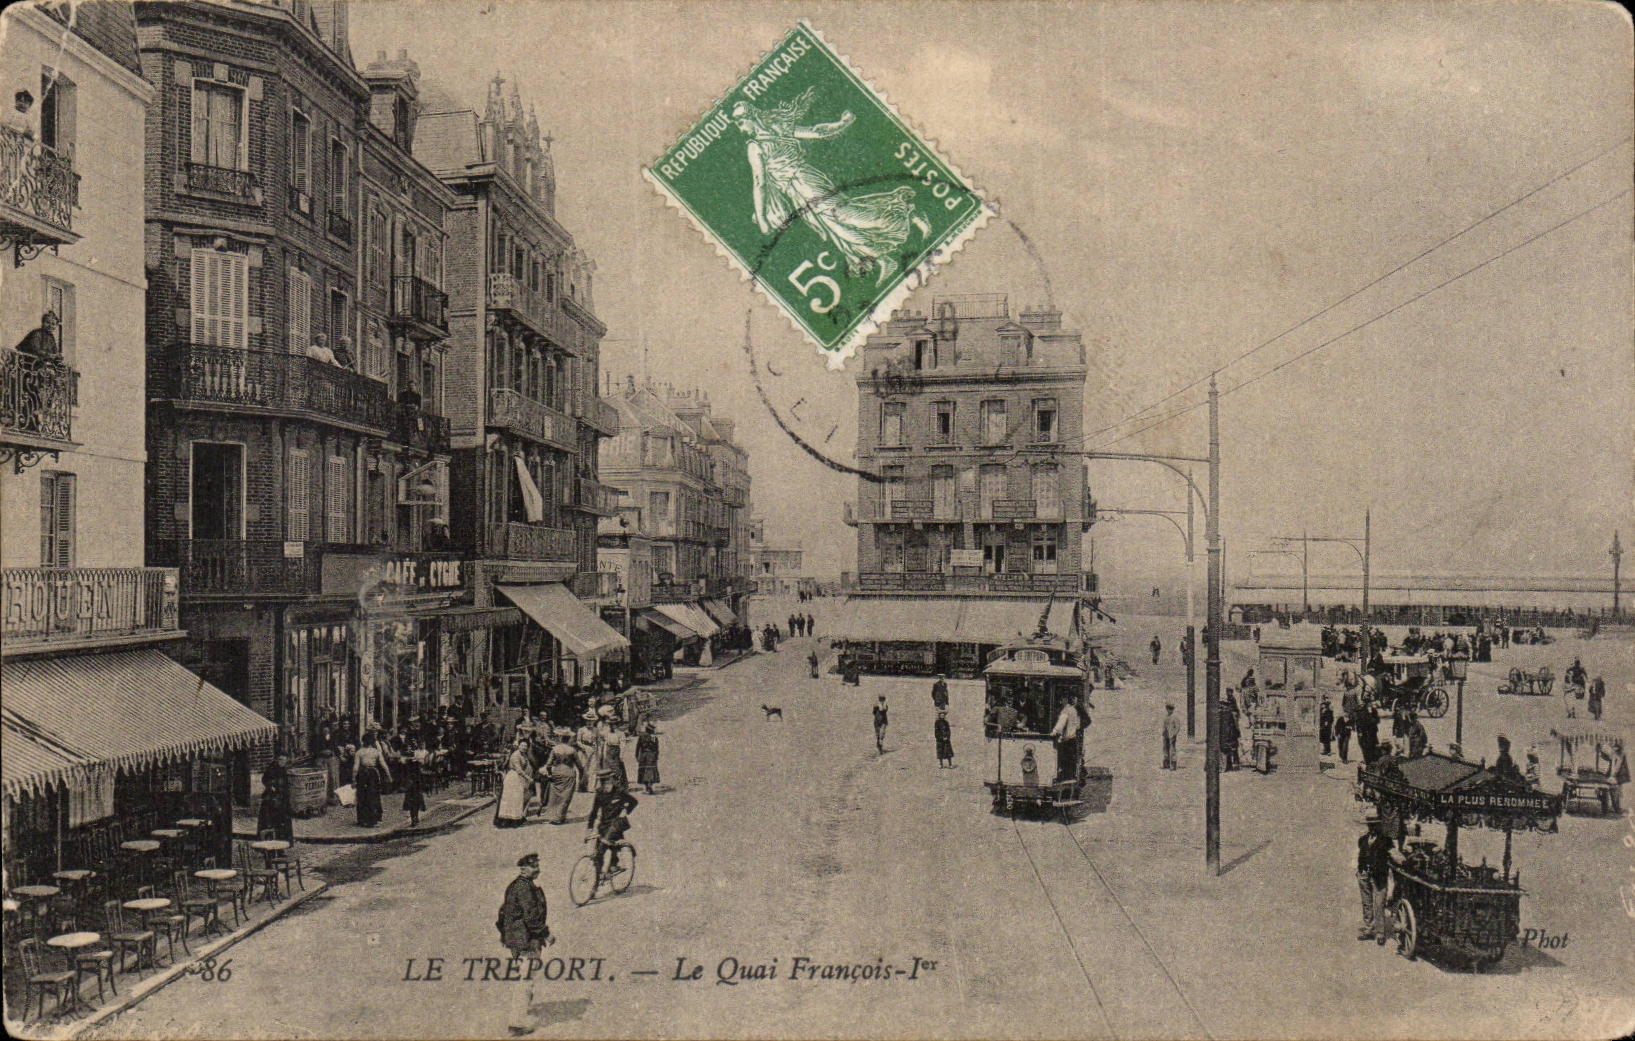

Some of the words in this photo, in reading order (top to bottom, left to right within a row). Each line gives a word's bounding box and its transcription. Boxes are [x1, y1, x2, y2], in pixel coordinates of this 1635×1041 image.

[660, 109, 734, 180] REPUBLIQUE
[742, 35, 812, 101] FRANÇAISE
[894, 142, 963, 211] POSTES
[7, 580, 115, 624] ROUEN
[1440, 794, 1454, 804] LA
[1457, 795, 1486, 805] PLUS
